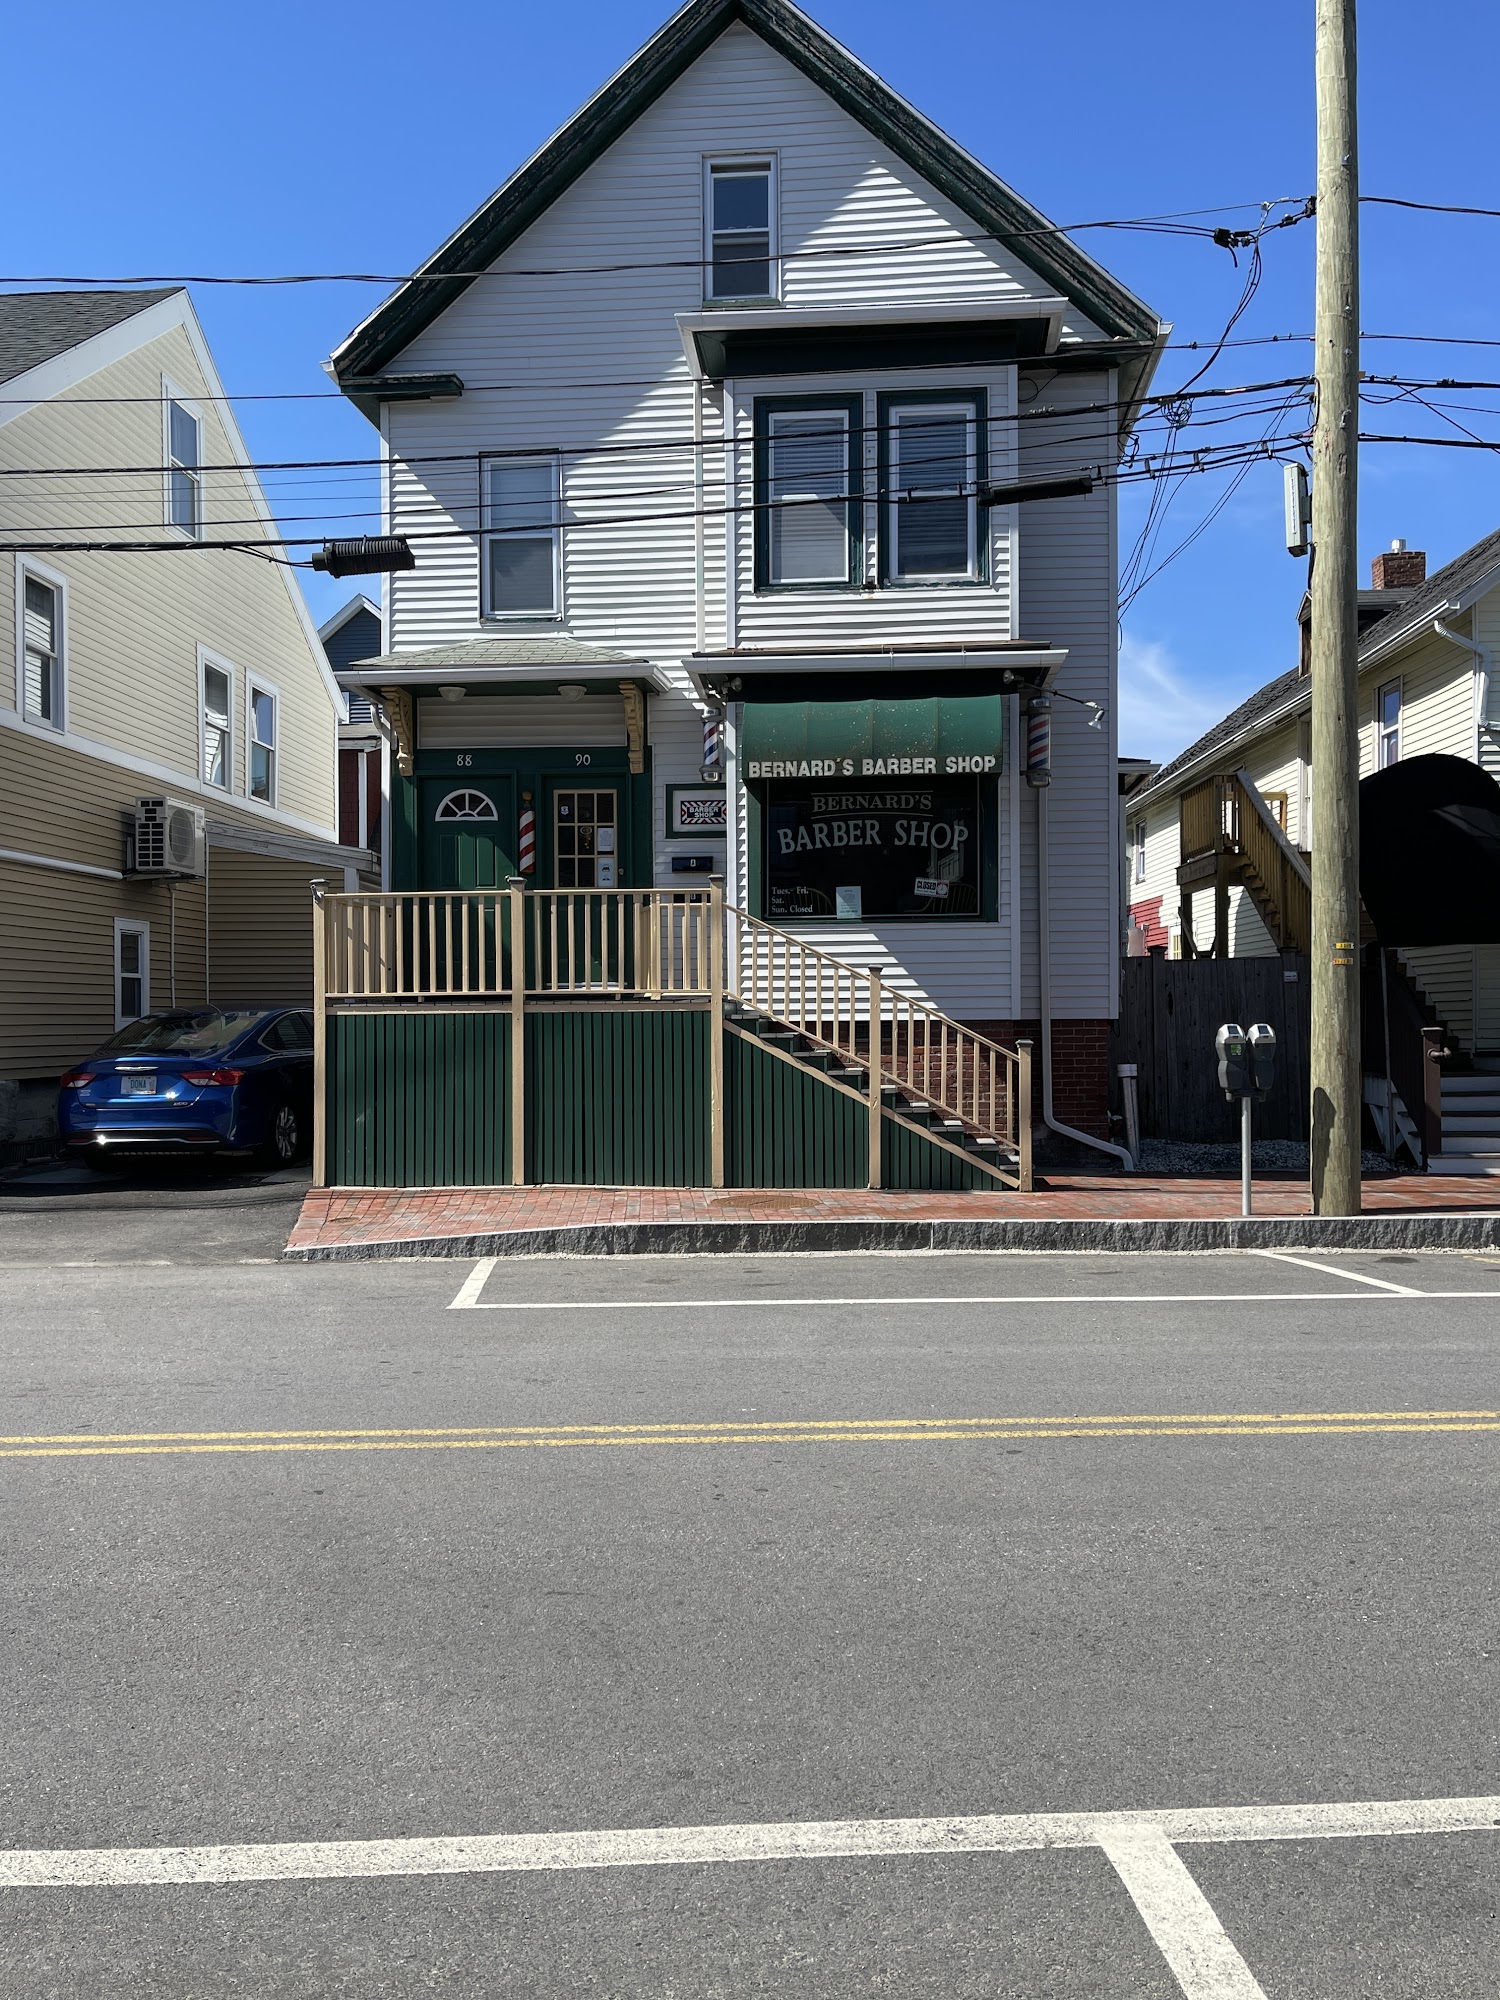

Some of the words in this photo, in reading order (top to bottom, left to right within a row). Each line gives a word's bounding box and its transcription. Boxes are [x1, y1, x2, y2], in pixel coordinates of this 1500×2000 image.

[456, 754, 473, 767] 88
[575, 753, 591, 767] 90
[749, 758, 854, 777] BERNARD'S
[861, 757, 937, 775] BARBER
[945, 755, 996, 774] SHOP
[812, 795, 931, 812] BERNARD'S
[777, 819, 881, 854] BARBER
[894, 819, 969, 851] SHOP
[796, 886, 808, 894] Fri.
[916, 880, 937, 891] CLOSED
[771, 896, 784, 904] Sat.
[789, 904, 813, 913] Closed
